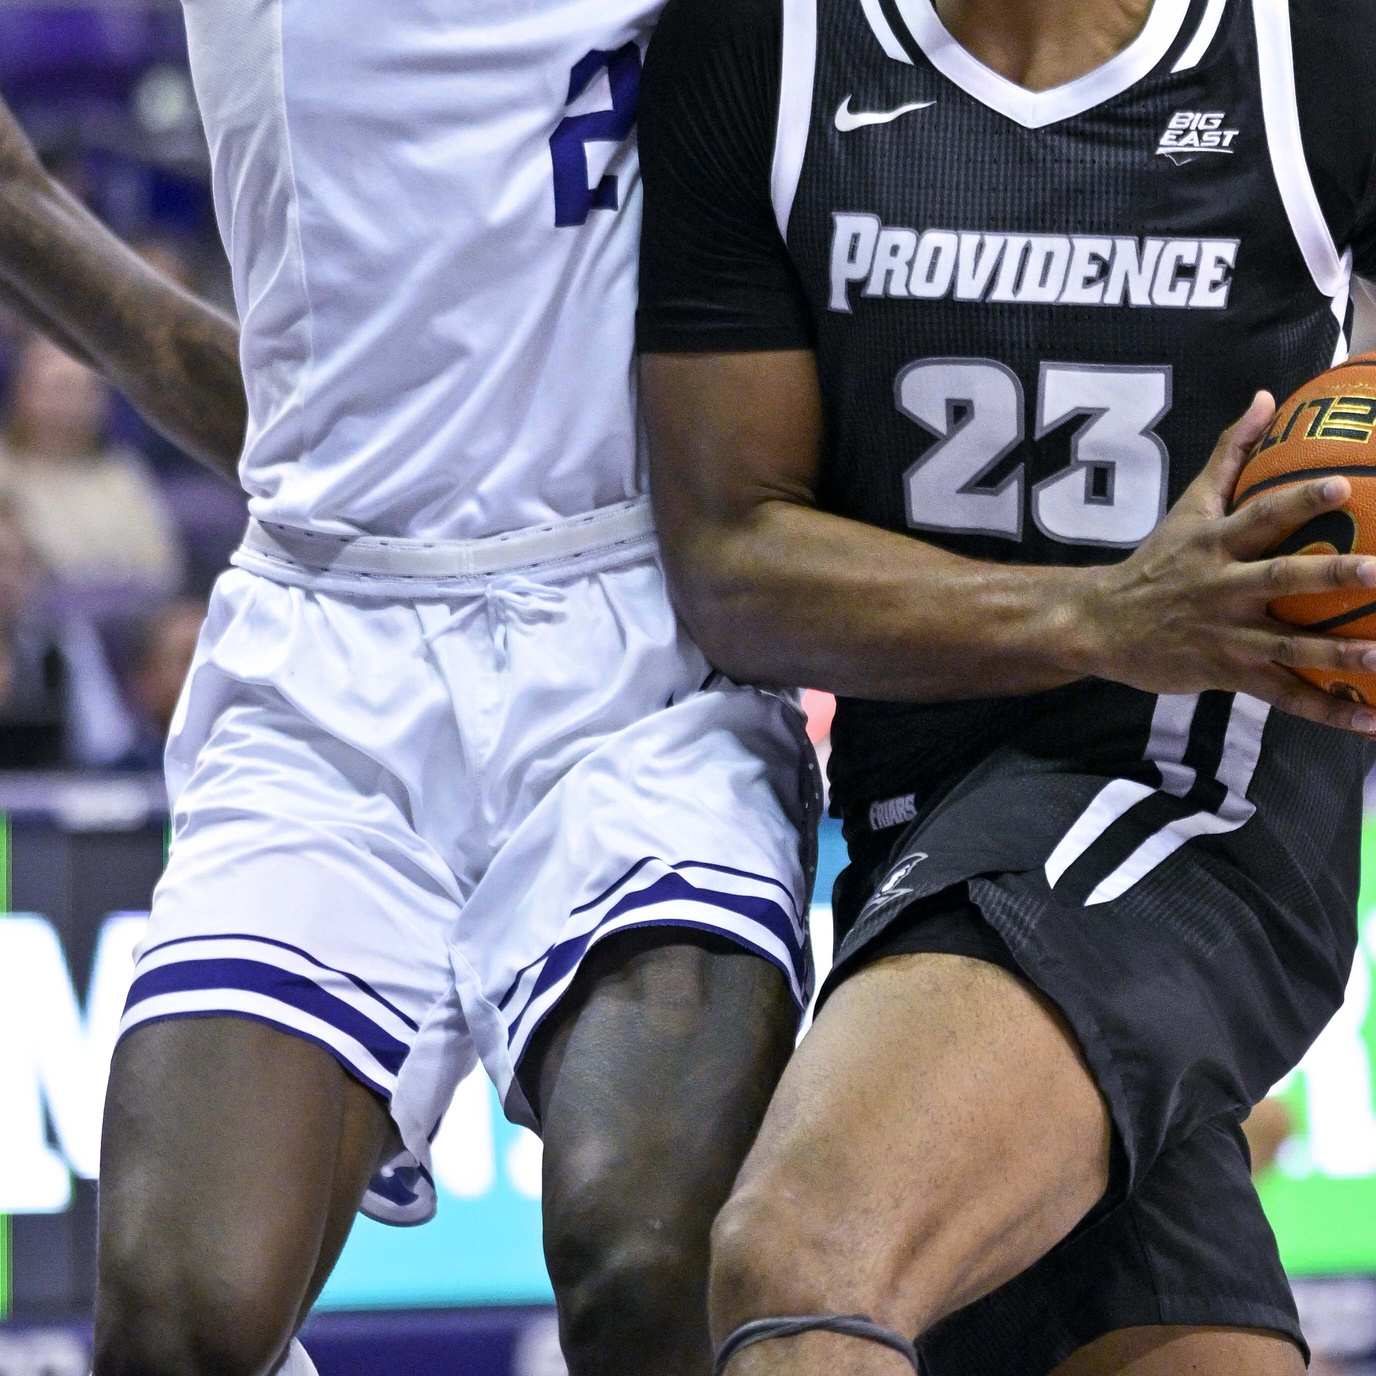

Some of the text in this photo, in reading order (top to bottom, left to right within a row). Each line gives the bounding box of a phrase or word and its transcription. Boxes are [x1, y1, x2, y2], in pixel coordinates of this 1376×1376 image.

[549, 41, 644, 227] 2
[1159, 129, 1240, 147] EAST
[1167, 111, 1226, 130] BIG
[827, 211, 1241, 314] PROVIDENCE
[893, 356, 1173, 549] 23
[869, 792, 917, 831] FRIARS
